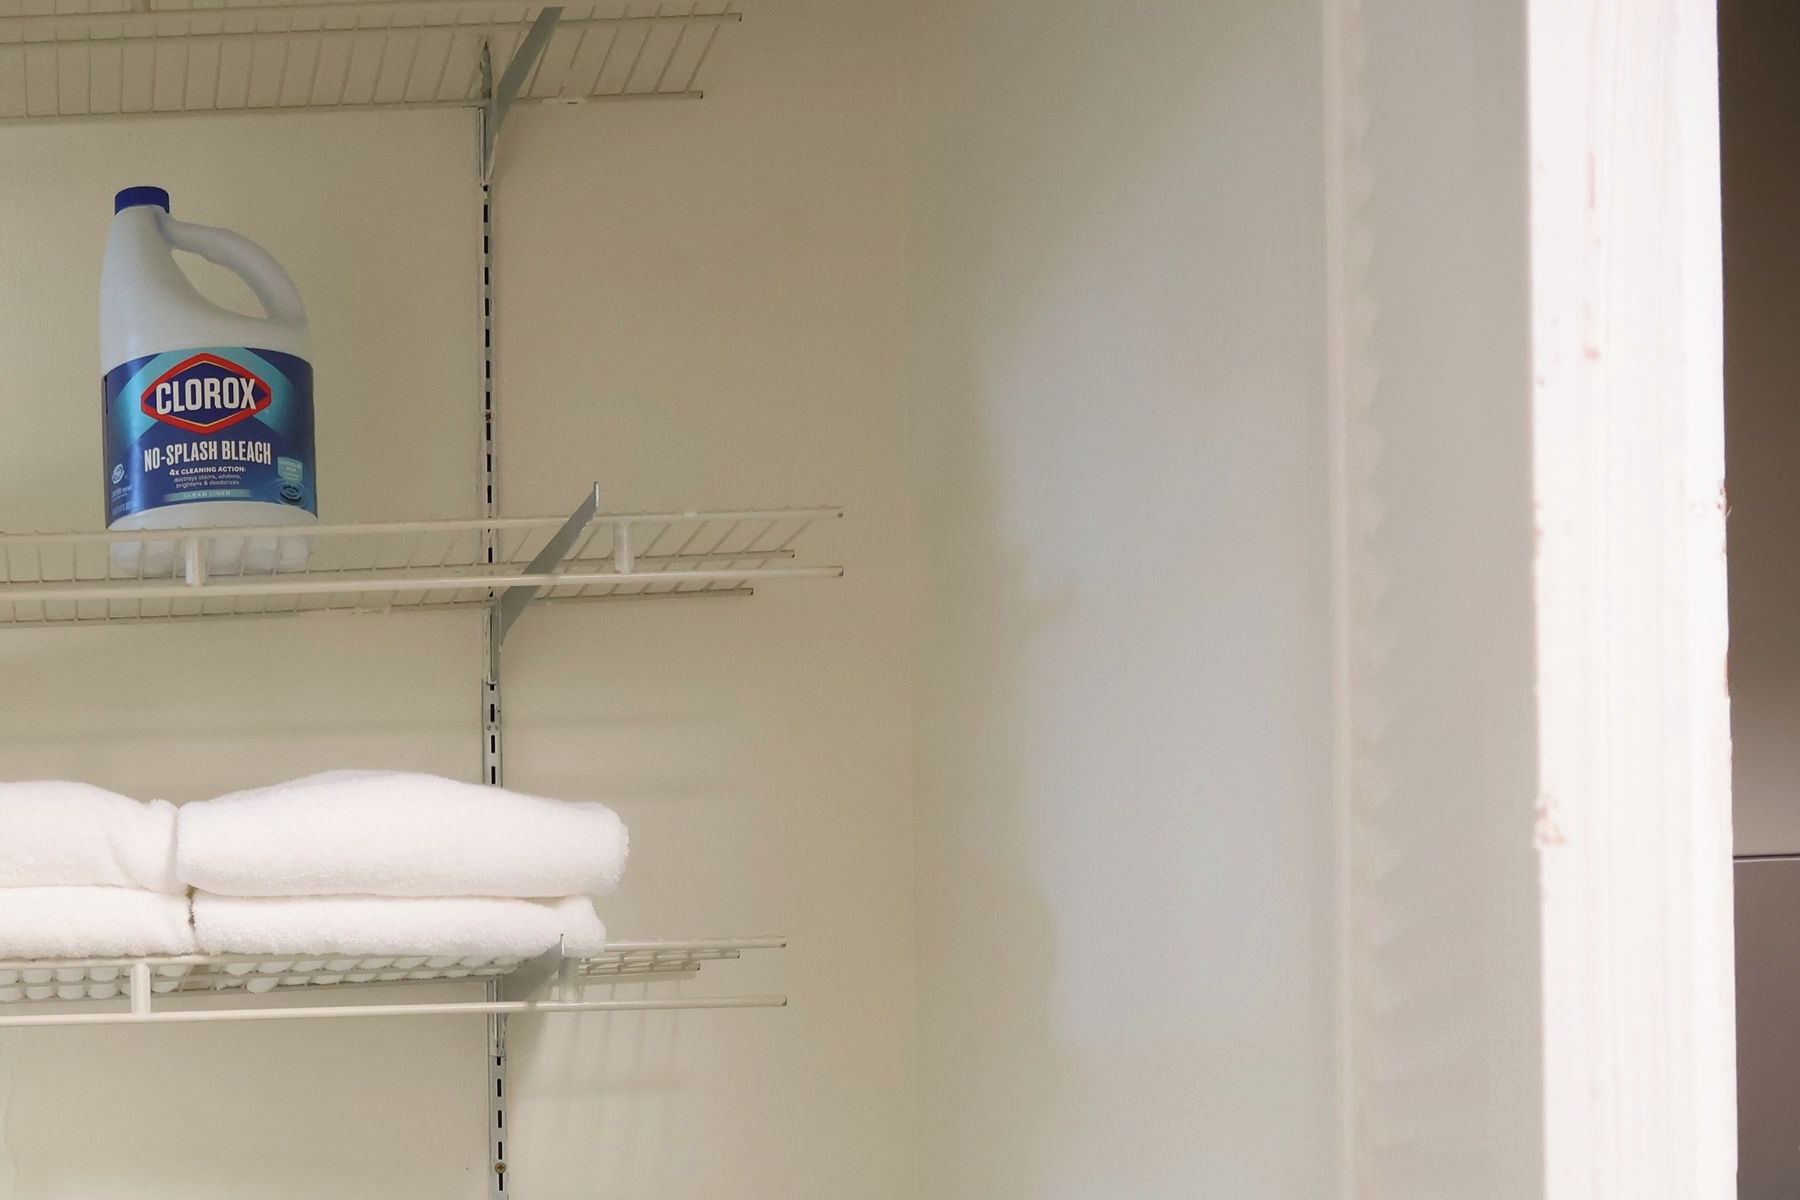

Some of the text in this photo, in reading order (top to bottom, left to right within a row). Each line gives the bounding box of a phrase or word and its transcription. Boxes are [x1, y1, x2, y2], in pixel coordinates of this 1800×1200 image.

[156, 377, 256, 414] CLOROX
[144, 440, 272, 472] NO-SPLASH BLEACH
[181, 467, 217, 475] CLEANING
